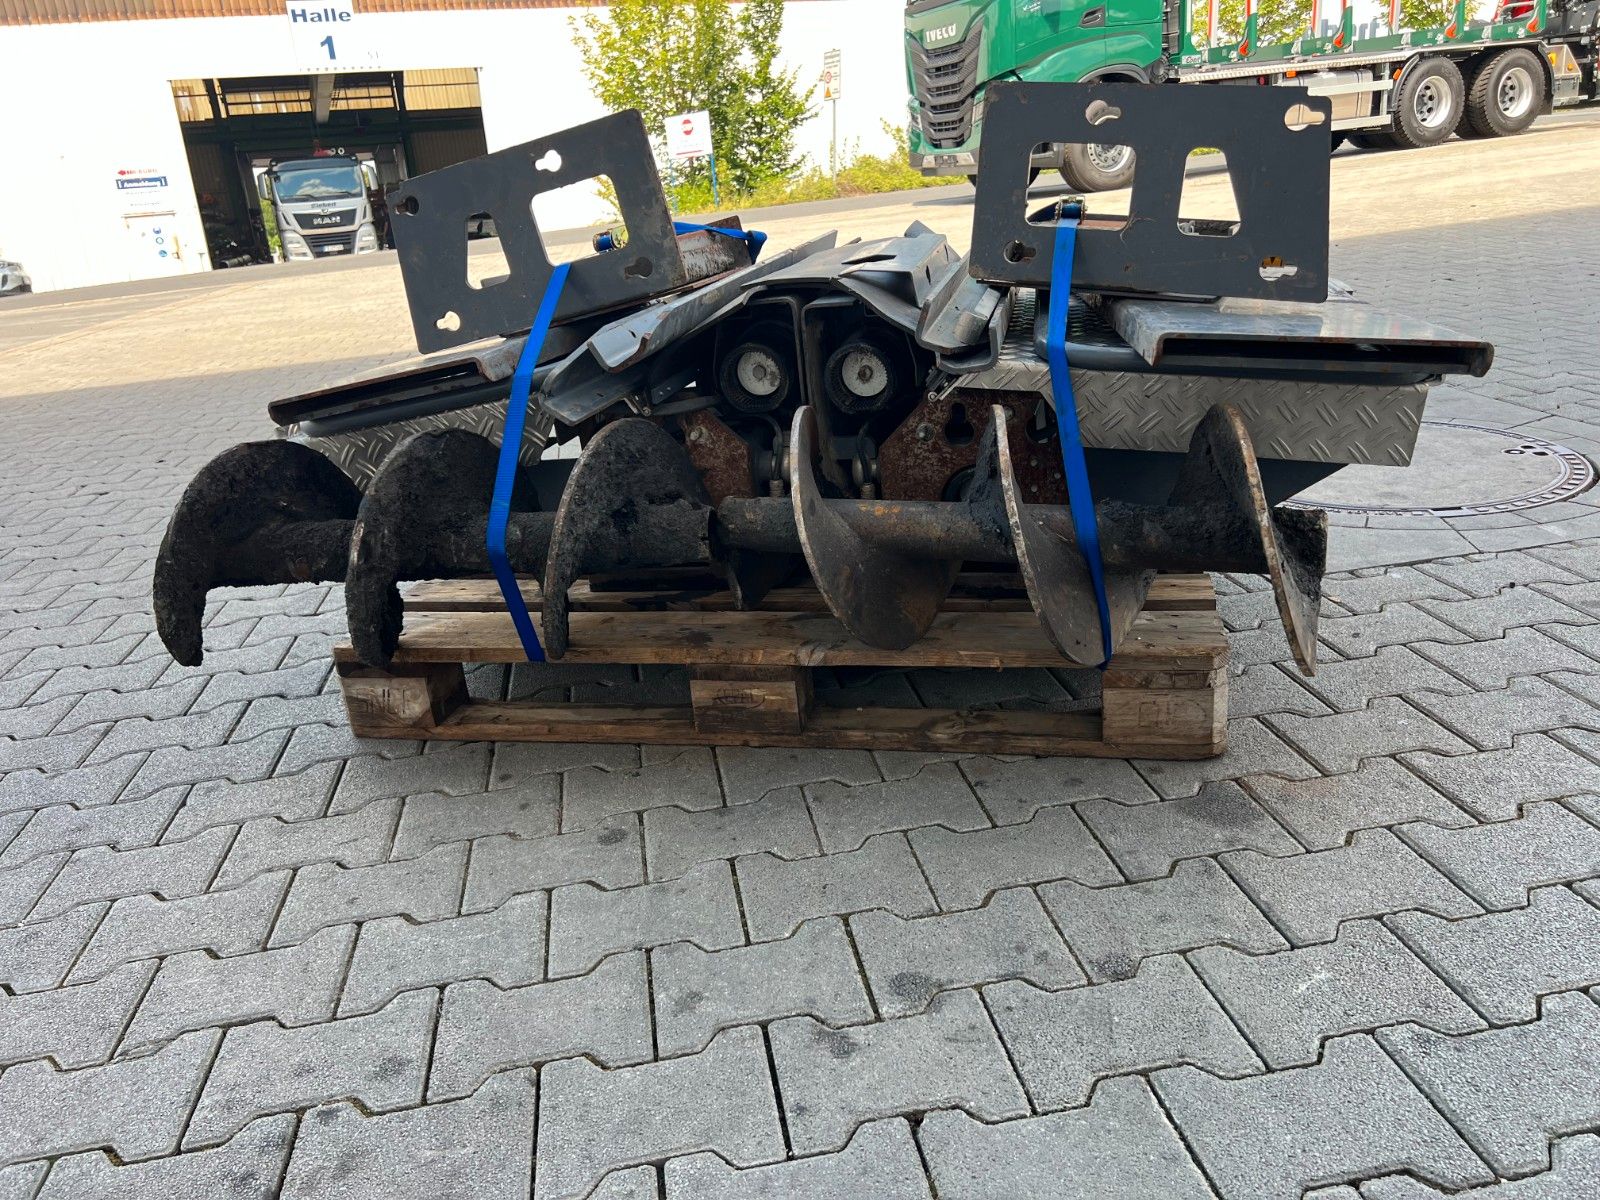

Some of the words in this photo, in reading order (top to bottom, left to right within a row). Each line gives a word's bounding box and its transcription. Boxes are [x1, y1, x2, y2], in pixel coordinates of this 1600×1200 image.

[291, 8, 351, 22] Halle
[926, 23, 956, 42] IVECO
[320, 35, 336, 60] 1
[313, 216, 340, 225] MAN
